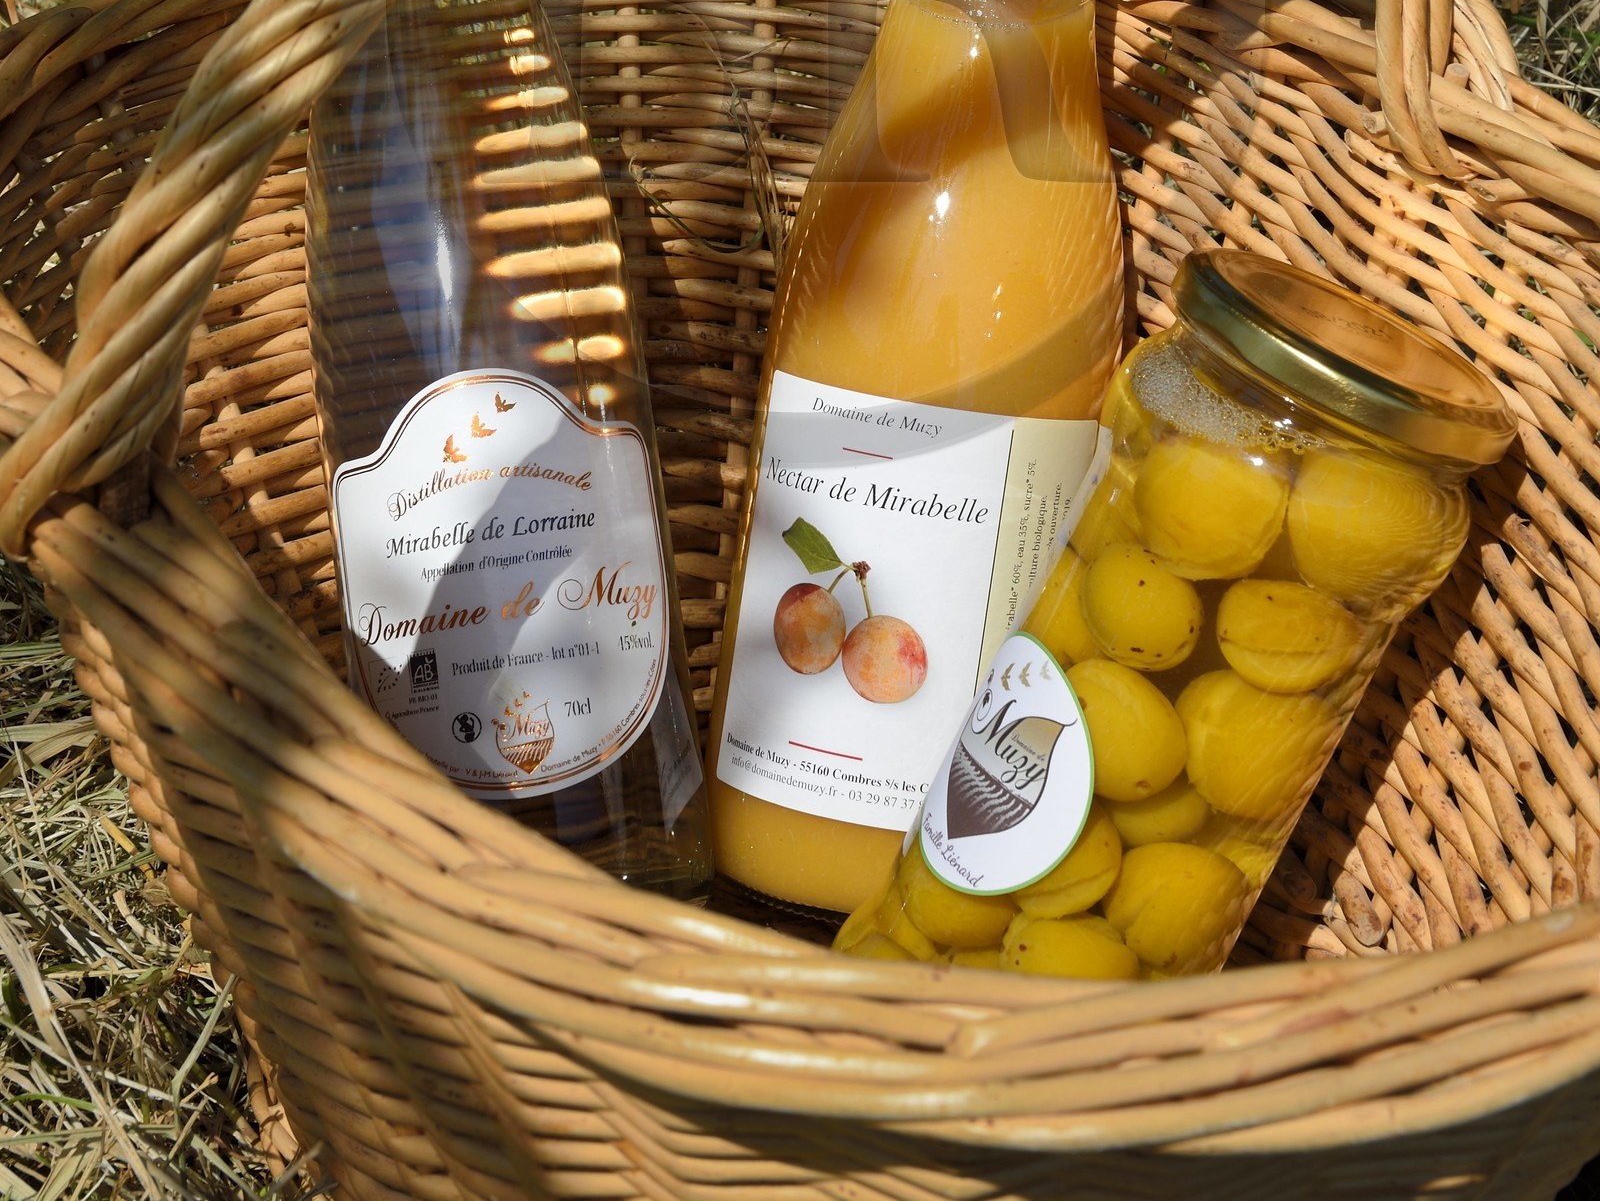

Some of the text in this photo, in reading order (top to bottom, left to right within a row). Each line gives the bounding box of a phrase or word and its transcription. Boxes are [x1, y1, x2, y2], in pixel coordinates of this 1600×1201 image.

[812, 397, 943, 438] Domaine de Muzy
[386, 461, 593, 522] Distillation artisanale
[766, 456, 989, 524] Nectar de Mirabelle
[1050, 482, 1063, 534] ouverture.
[386, 508, 595, 559] Mirabelle de Lorraine
[1017, 537, 1026, 558] eau
[420, 545, 573, 582] Appellation d'Origine Contrôlée
[358, 561, 658, 647] Domaine de Muzy
[413, 663, 434, 684] AB
[451, 658, 491, 676] Produit
[492, 655, 505, 671] de
[508, 651, 543, 667] France
[552, 646, 566, 661] lot
[564, 698, 592, 717] 70cl
[541, 759, 572, 774] Domaine
[572, 755, 581, 763] de
[581, 745, 598, 760] Muzy
[727, 732, 753, 754] Domaine
[755, 746, 765, 758] de
[766, 750, 791, 769] Muzy
[799, 760, 830, 777] 55160
[832, 768, 882, 788] Combres
[902, 781, 917, 793] les
[971, 695, 1048, 791] Muzy
[1011, 733, 1036, 756] Domaine
[731, 753, 839, 797] info@domainedemuzy.fr
[848, 789, 862, 802] 03
[866, 793, 880, 805] 29
[883, 795, 897, 807] 87
[901, 797, 915, 809] 37
[922, 812, 985, 888] Famille Liénard
